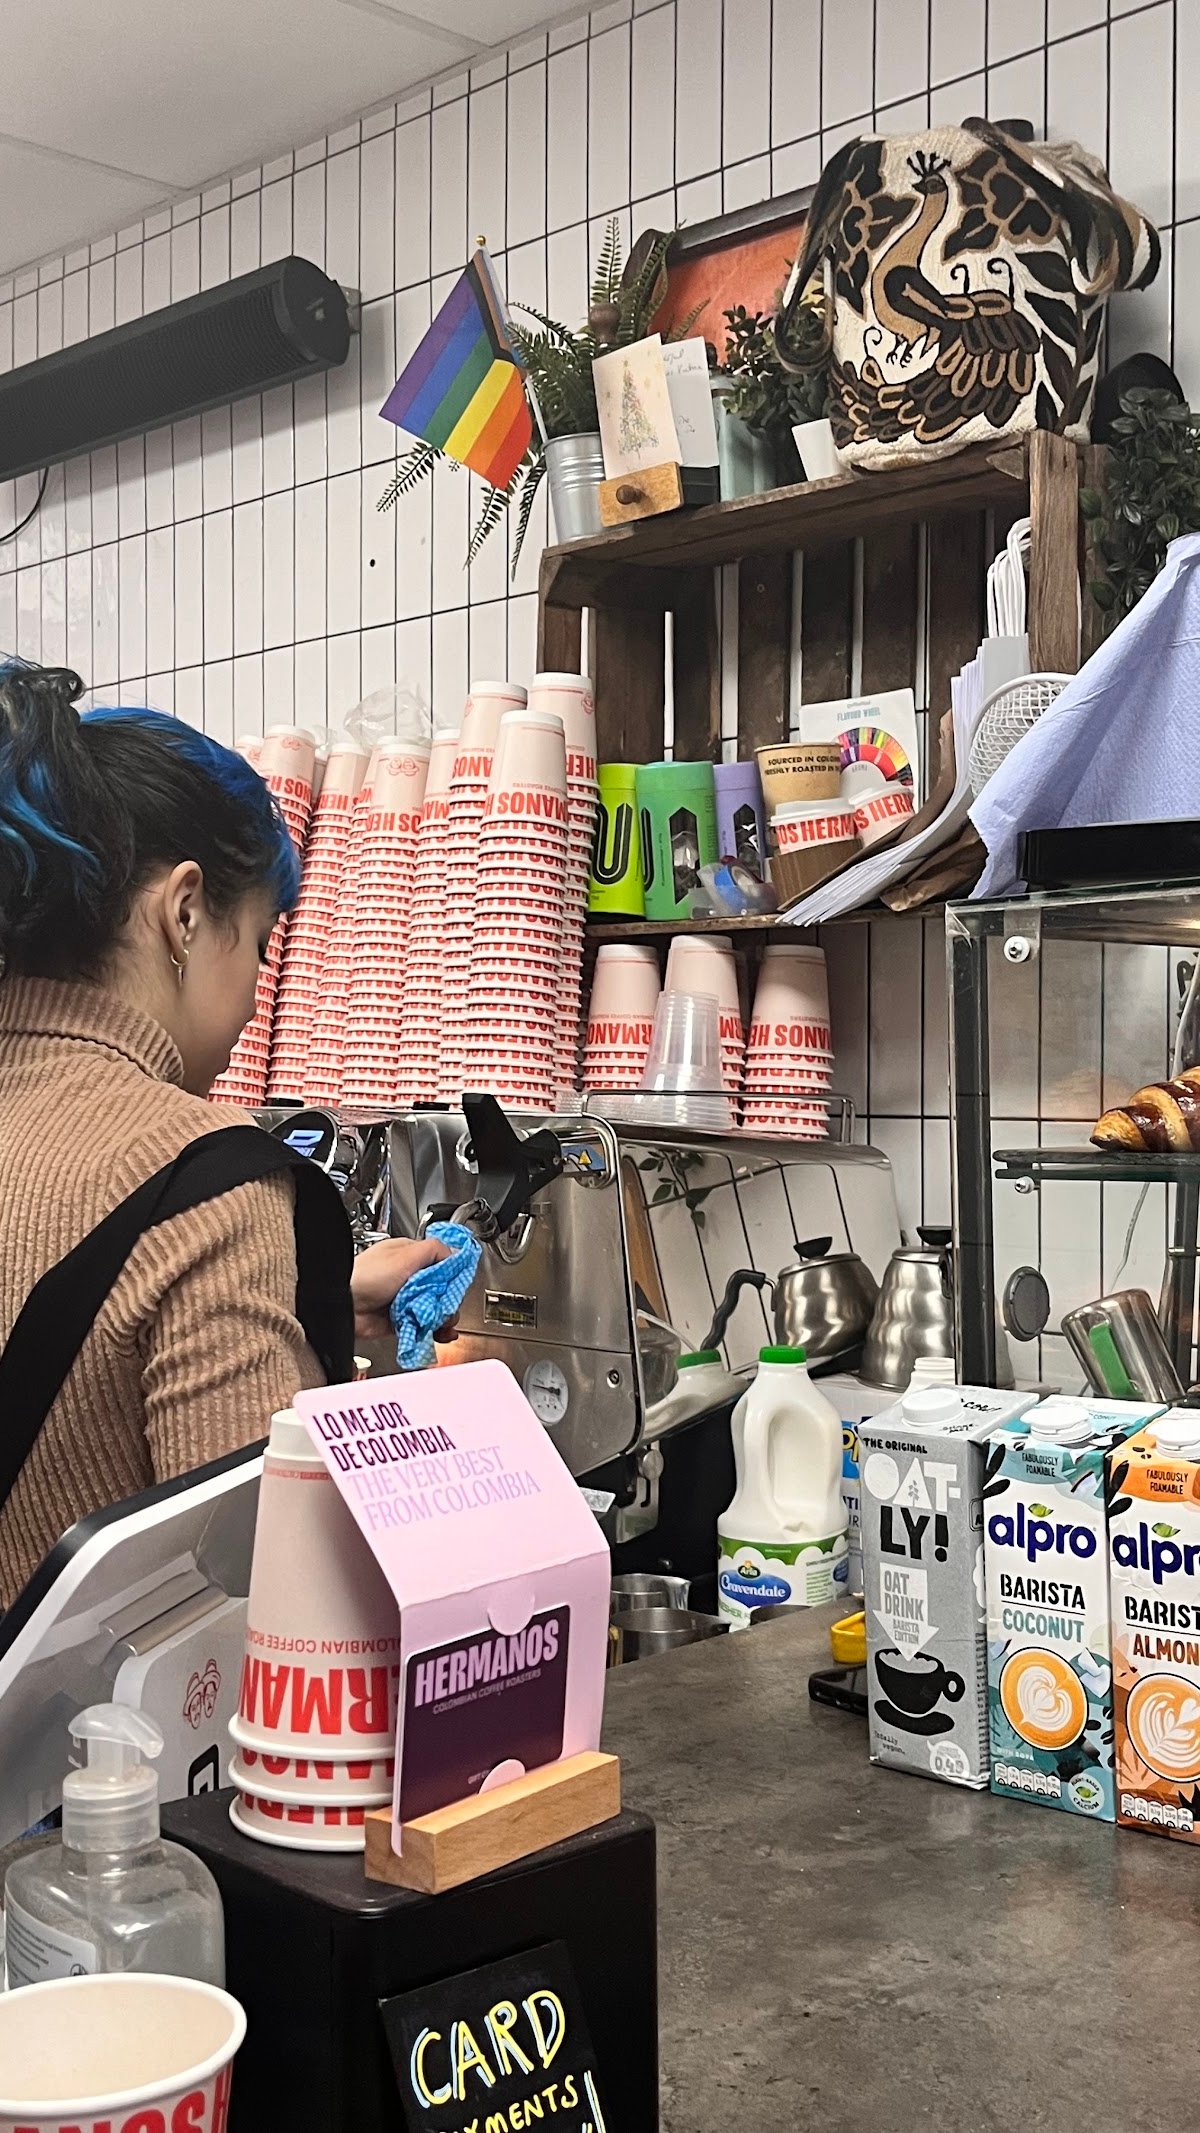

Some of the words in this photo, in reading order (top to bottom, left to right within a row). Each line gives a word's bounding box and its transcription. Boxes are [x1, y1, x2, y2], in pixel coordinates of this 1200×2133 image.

[768, 756, 803, 766] SOURCED
[792, 765, 827, 773] ROASTED
[313, 1412, 344, 1441] LO
[339, 1402, 411, 1435] MEJOR
[329, 1445, 363, 1472] DE
[356, 1425, 456, 1467] COLOMBIA
[863, 1437, 884, 1449] THE
[885, 1440, 928, 1454] ORIGINAL
[1022, 1452, 1059, 1466] FABULOUSLY
[347, 1467, 397, 1501] THE
[395, 1456, 452, 1490] VERY
[454, 1445, 506, 1480] BEST
[1025, 1465, 1056, 1477] FOAMABLE
[1146, 1468, 1189, 1483] FABULOUSLY
[363, 1493, 434, 1531] FROM
[432, 1469, 542, 1515] COLOMBIA
[1150, 1481, 1184, 1495] FOAMABLE
[880, 1504, 949, 1562] LY!
[988, 1502, 1097, 1563] alpro
[1112, 1521, 1200, 1585] alpr
[721, 1574, 786, 1598] Cravendale
[884, 1570, 910, 1595] OAT
[1000, 1573, 1086, 1610] BARISTA
[885, 1592, 924, 1622] DRINK
[893, 1618, 920, 1634] BARISTA
[894, 1630, 920, 1645] EDITION
[1002, 1607, 1085, 1643] COCONUT
[267, 1630, 317, 1654] COFFEE
[1132, 1633, 1200, 1666] ALMON
[414, 1619, 560, 1708] HERMANOS
[1072, 1797, 1100, 1811] CALCIUM
[411, 1989, 566, 2109] CARD
